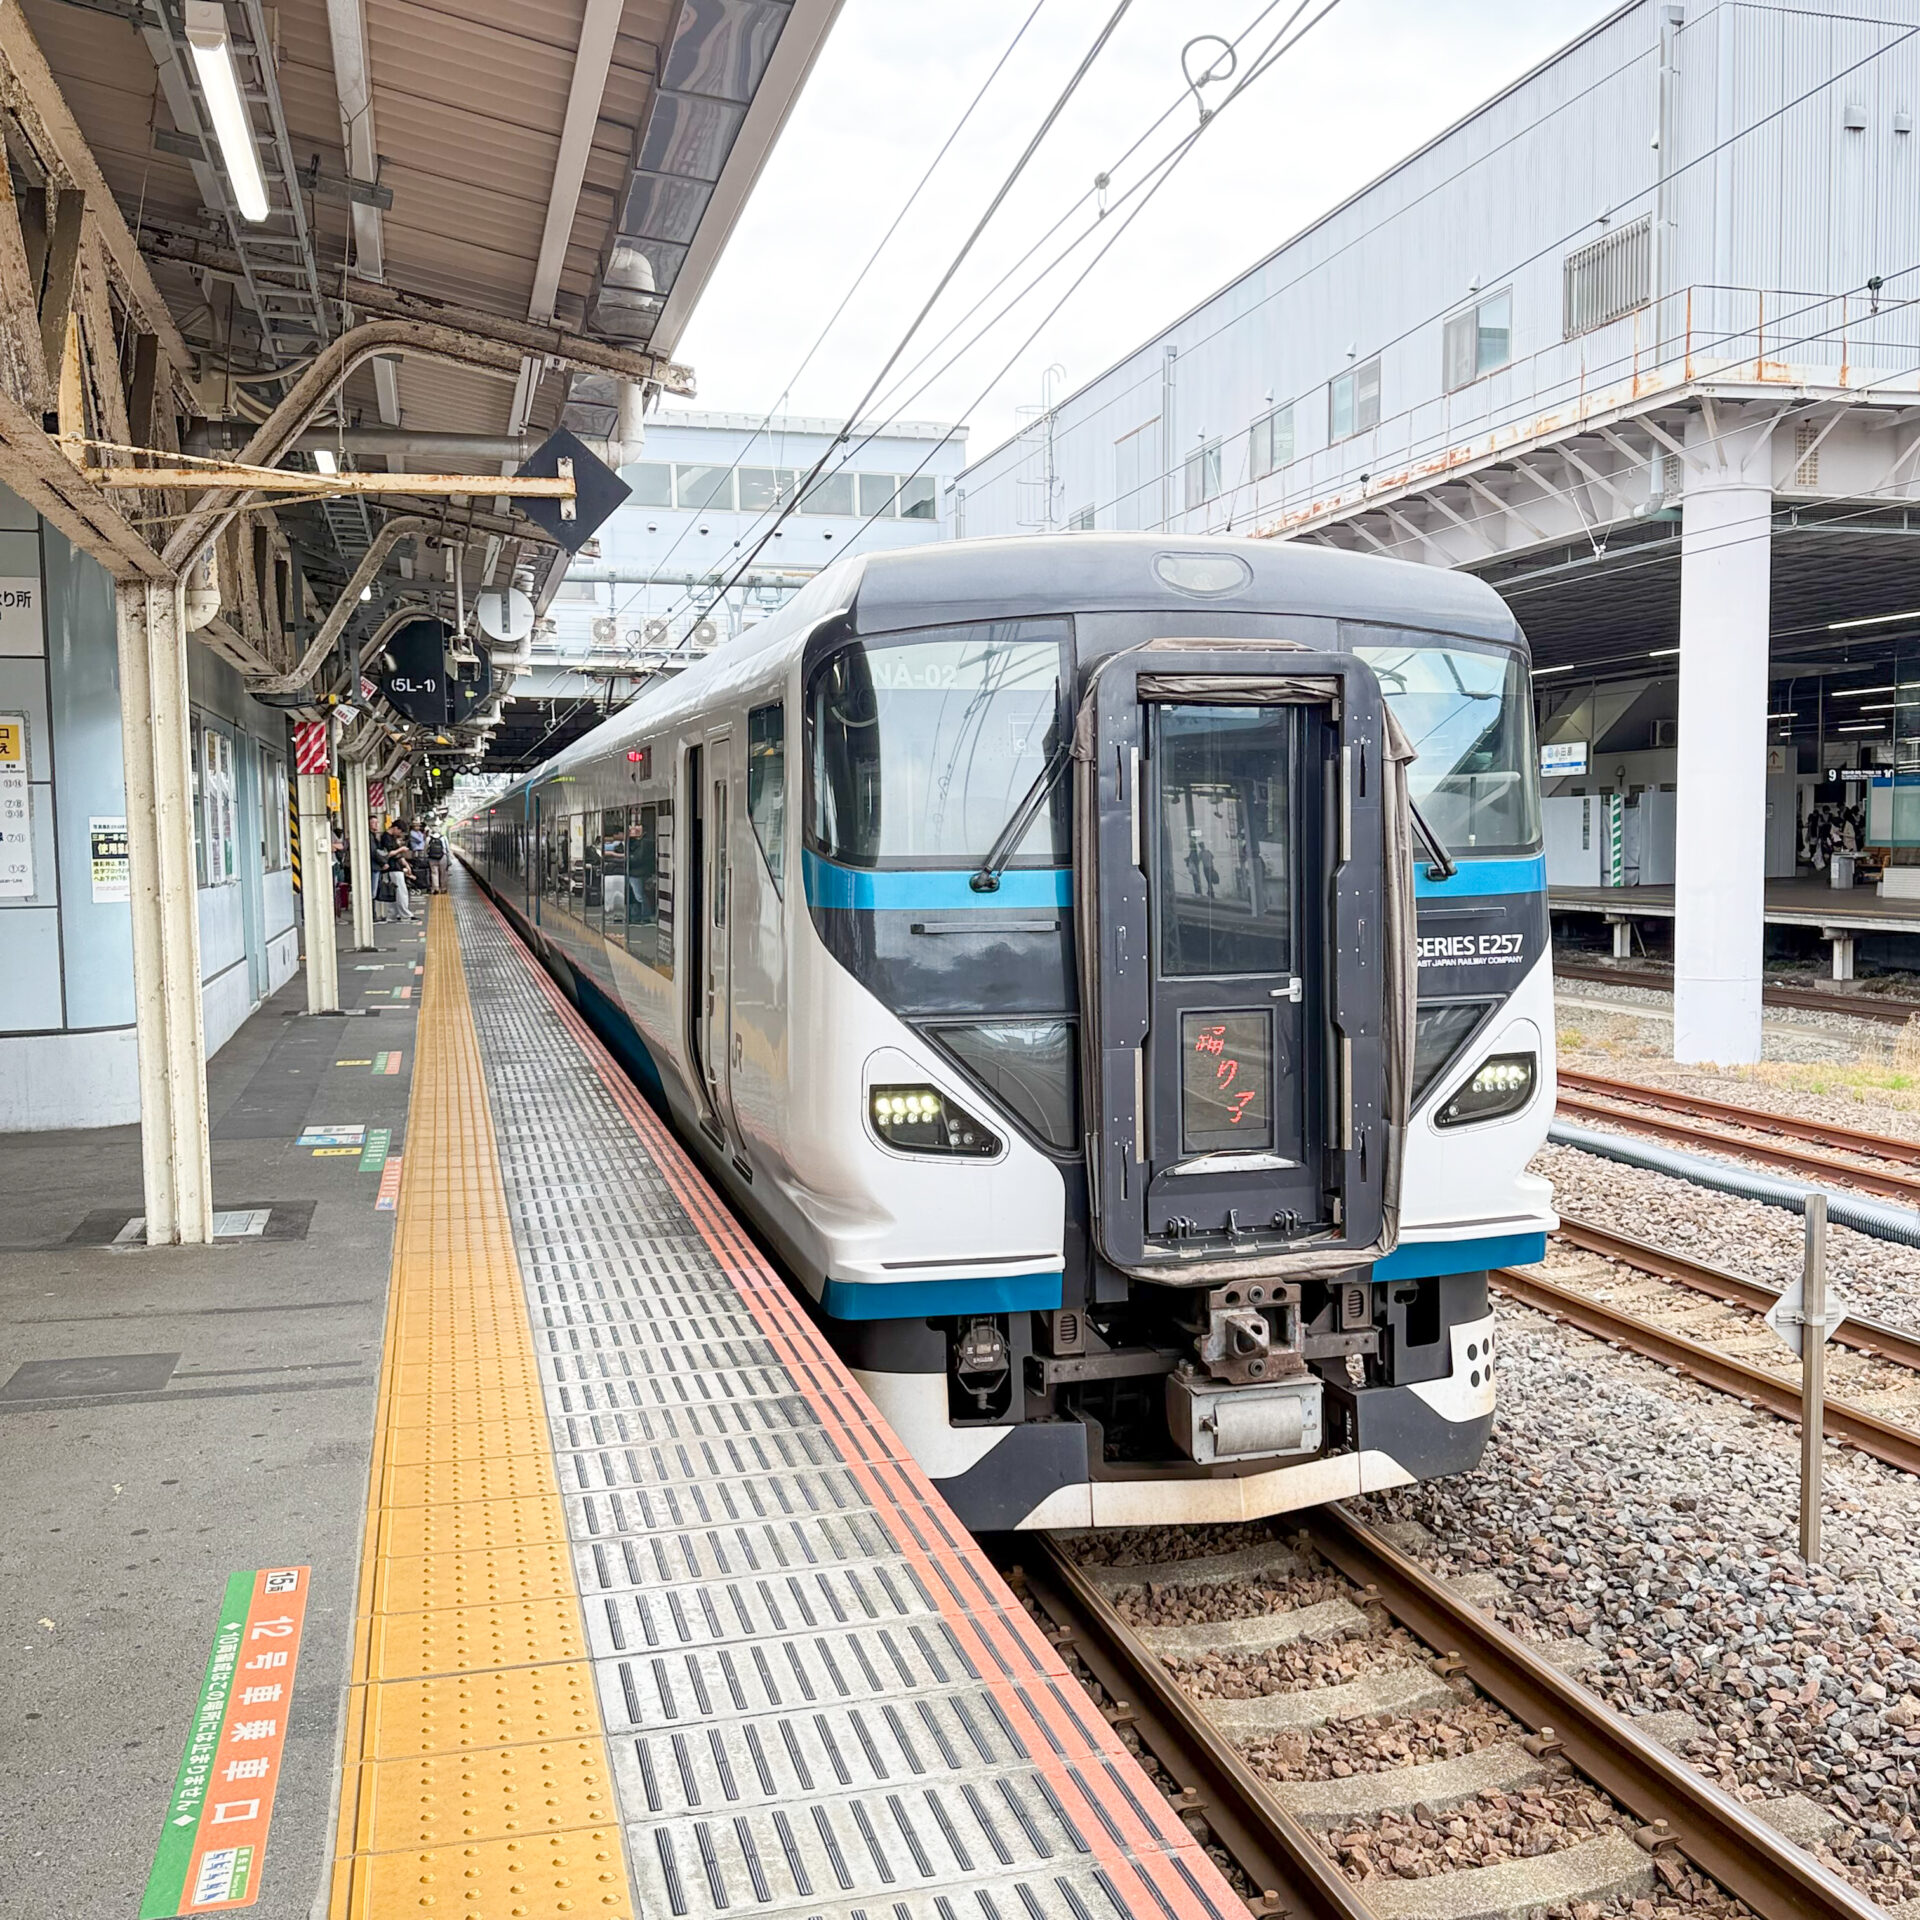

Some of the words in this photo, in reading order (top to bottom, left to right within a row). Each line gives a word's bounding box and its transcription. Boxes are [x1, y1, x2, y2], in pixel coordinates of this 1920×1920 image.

[0, 590, 32, 608] り所
[873, 663, 958, 687] NA-02
[391, 678, 436, 693] (5L-1)
[1828, 769, 1837, 781] 9
[1478, 933, 1524, 955] E257
[1417, 959, 1432, 968] AST
[1432, 958, 1457, 967] JAPAN
[1457, 956, 1488, 966] RAILWAY
[1487, 955, 1524, 965] COMPANY
